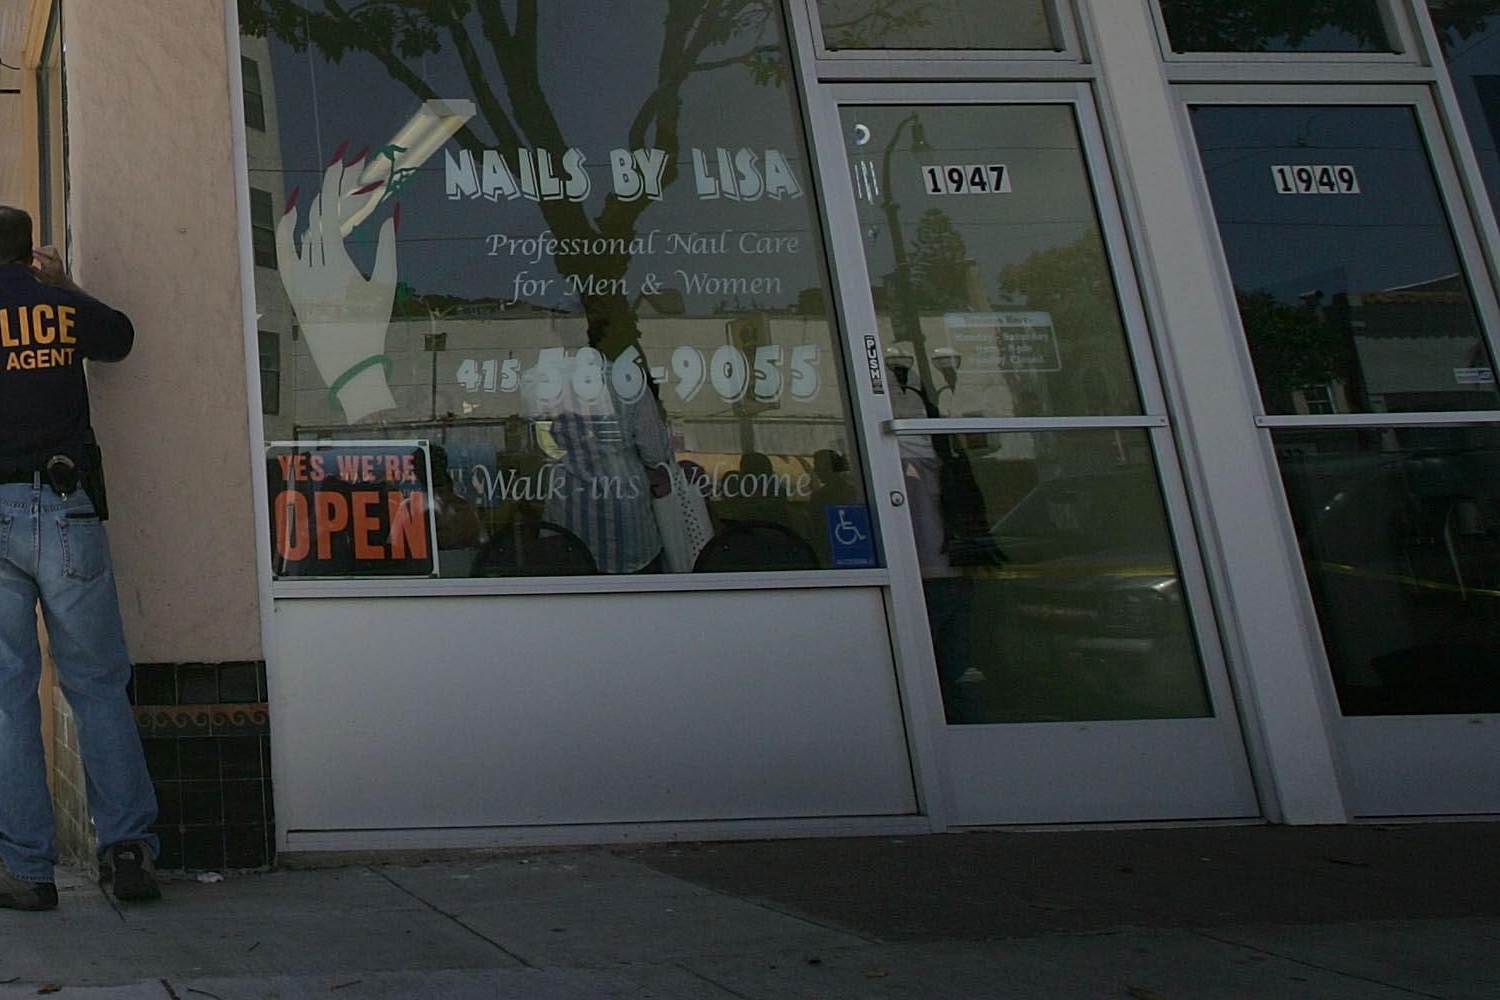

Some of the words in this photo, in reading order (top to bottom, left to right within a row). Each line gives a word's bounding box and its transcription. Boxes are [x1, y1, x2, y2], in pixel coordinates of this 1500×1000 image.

[444, 147, 591, 202] NAILS
[610, 147, 670, 201] BY
[692, 147, 804, 202] LISA
[926, 165, 1006, 193] 1947
[1276, 165, 1357, 193] 1949
[486, 230, 660, 265] Professional
[667, 230, 729, 255] Nail
[739, 231, 800, 255] Care
[506, 270, 554, 306] for
[563, 273, 629, 296] Men
[640, 272, 663, 297] &
[675, 270, 782, 296] Women
[6, 347, 76, 371] AGENT
[865, 339, 881, 379] PUSH
[278, 455, 326, 482] YES
[337, 455, 418, 483] WE'RE
[655, 461, 813, 501] Welcome
[274, 490, 429, 561] OPEN
